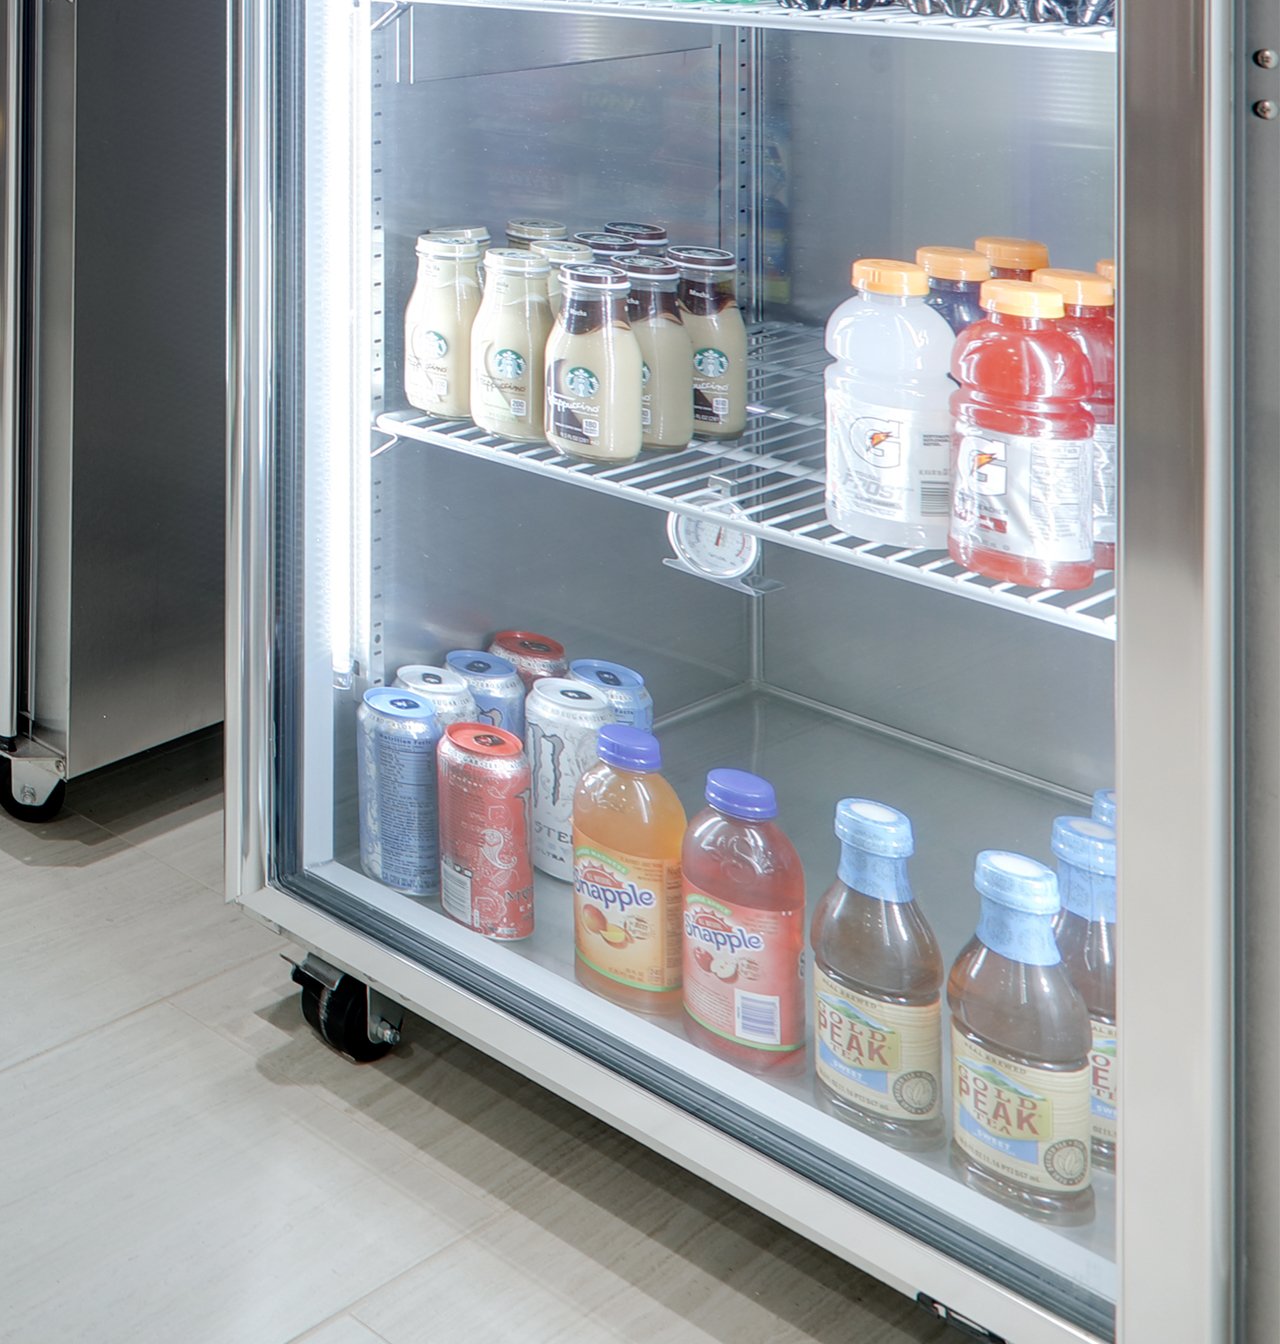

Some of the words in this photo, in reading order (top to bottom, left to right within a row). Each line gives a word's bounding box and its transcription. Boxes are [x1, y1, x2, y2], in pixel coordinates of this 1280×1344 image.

[585, 420, 597, 428] 180
[575, 868, 655, 911] Snapple
[685, 912, 763, 954] Snapple
[818, 1000, 887, 1042] GOLD
[818, 1008, 888, 1066] PEAK
[832, 1044, 864, 1066] TEA
[958, 1065, 1038, 1111] GOLD
[959, 1076, 1039, 1136] PEAK
[973, 1111, 1012, 1136] TEA
